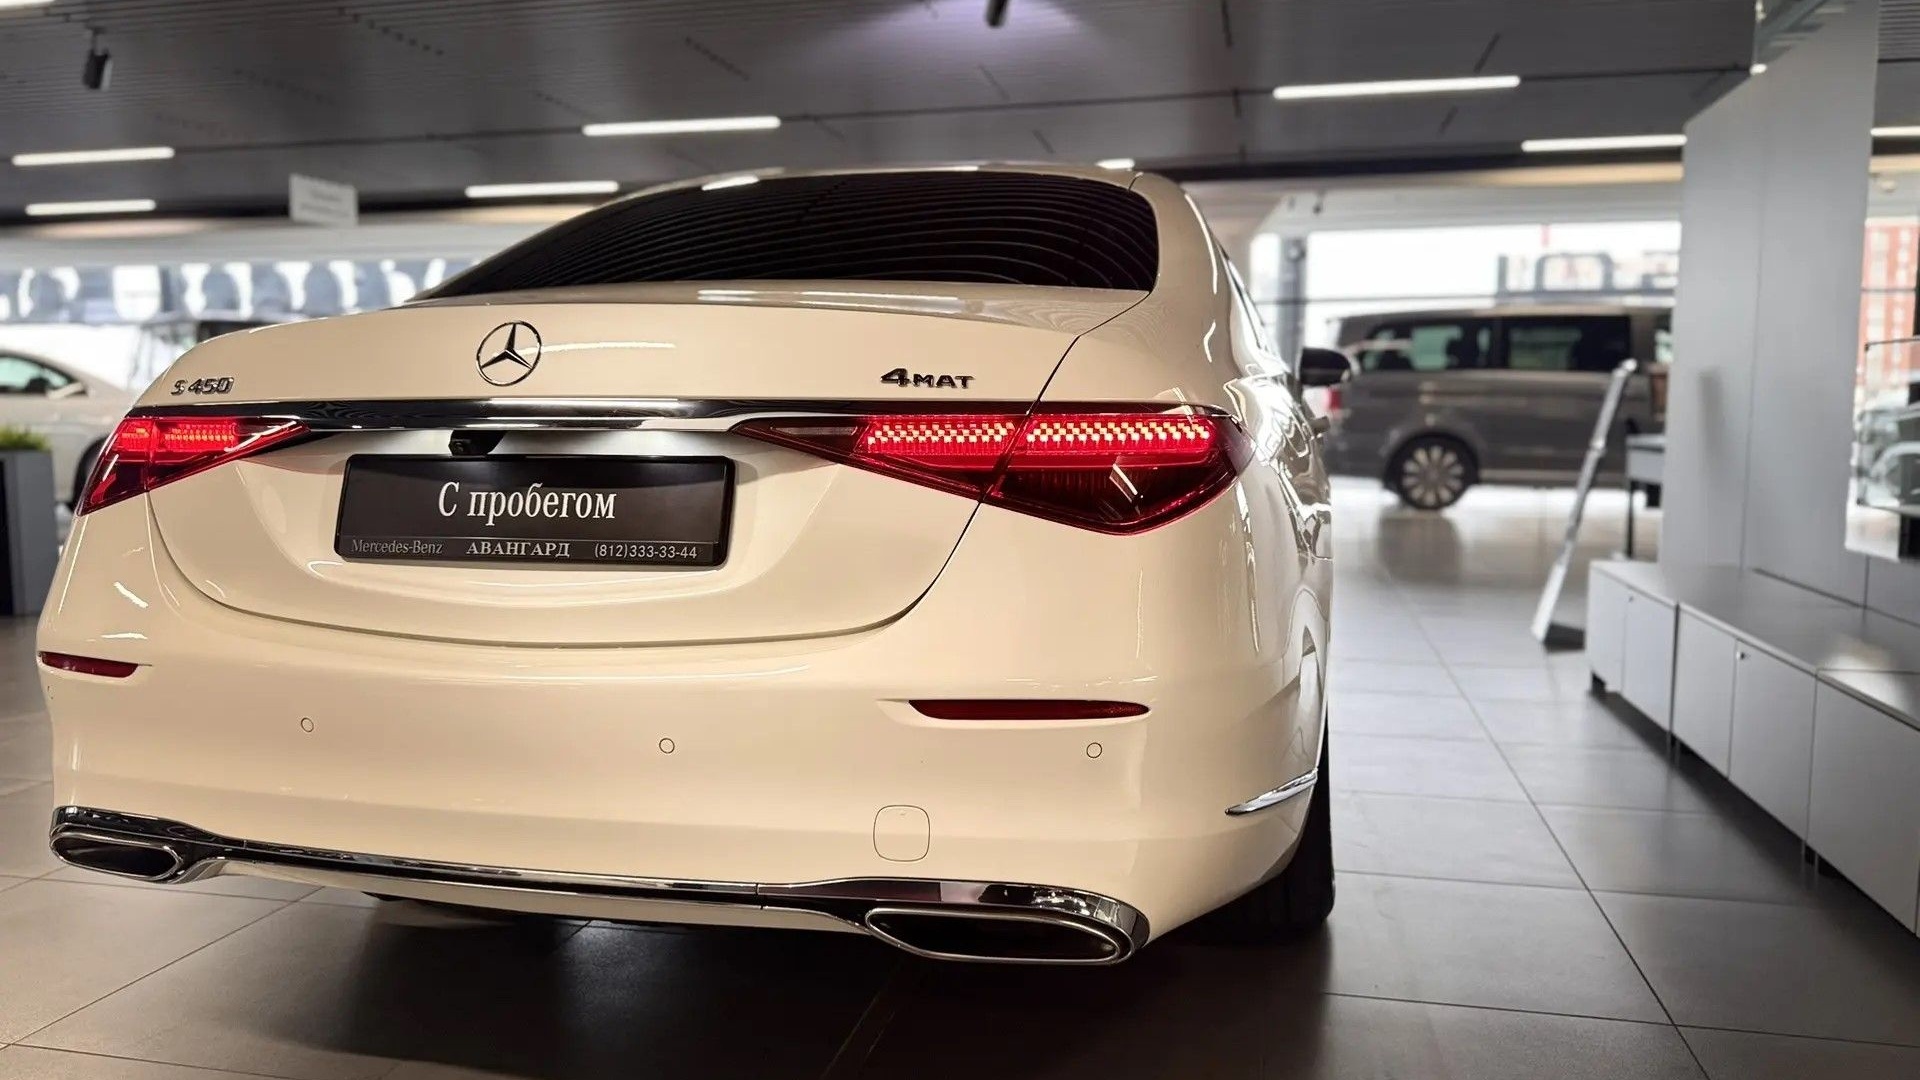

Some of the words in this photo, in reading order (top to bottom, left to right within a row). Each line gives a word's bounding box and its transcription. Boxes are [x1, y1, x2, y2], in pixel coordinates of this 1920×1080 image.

[171, 379, 187, 396] S
[188, 376, 234, 395] 450
[880, 367, 976, 389] 4MAT
[438, 481, 460, 517] С
[467, 482, 617, 527] пробегом
[352, 538, 444, 555] Mercedes-Benz
[466, 541, 571, 558] АВАНГАРД
[594, 543, 698, 560] (812)333-33-44
